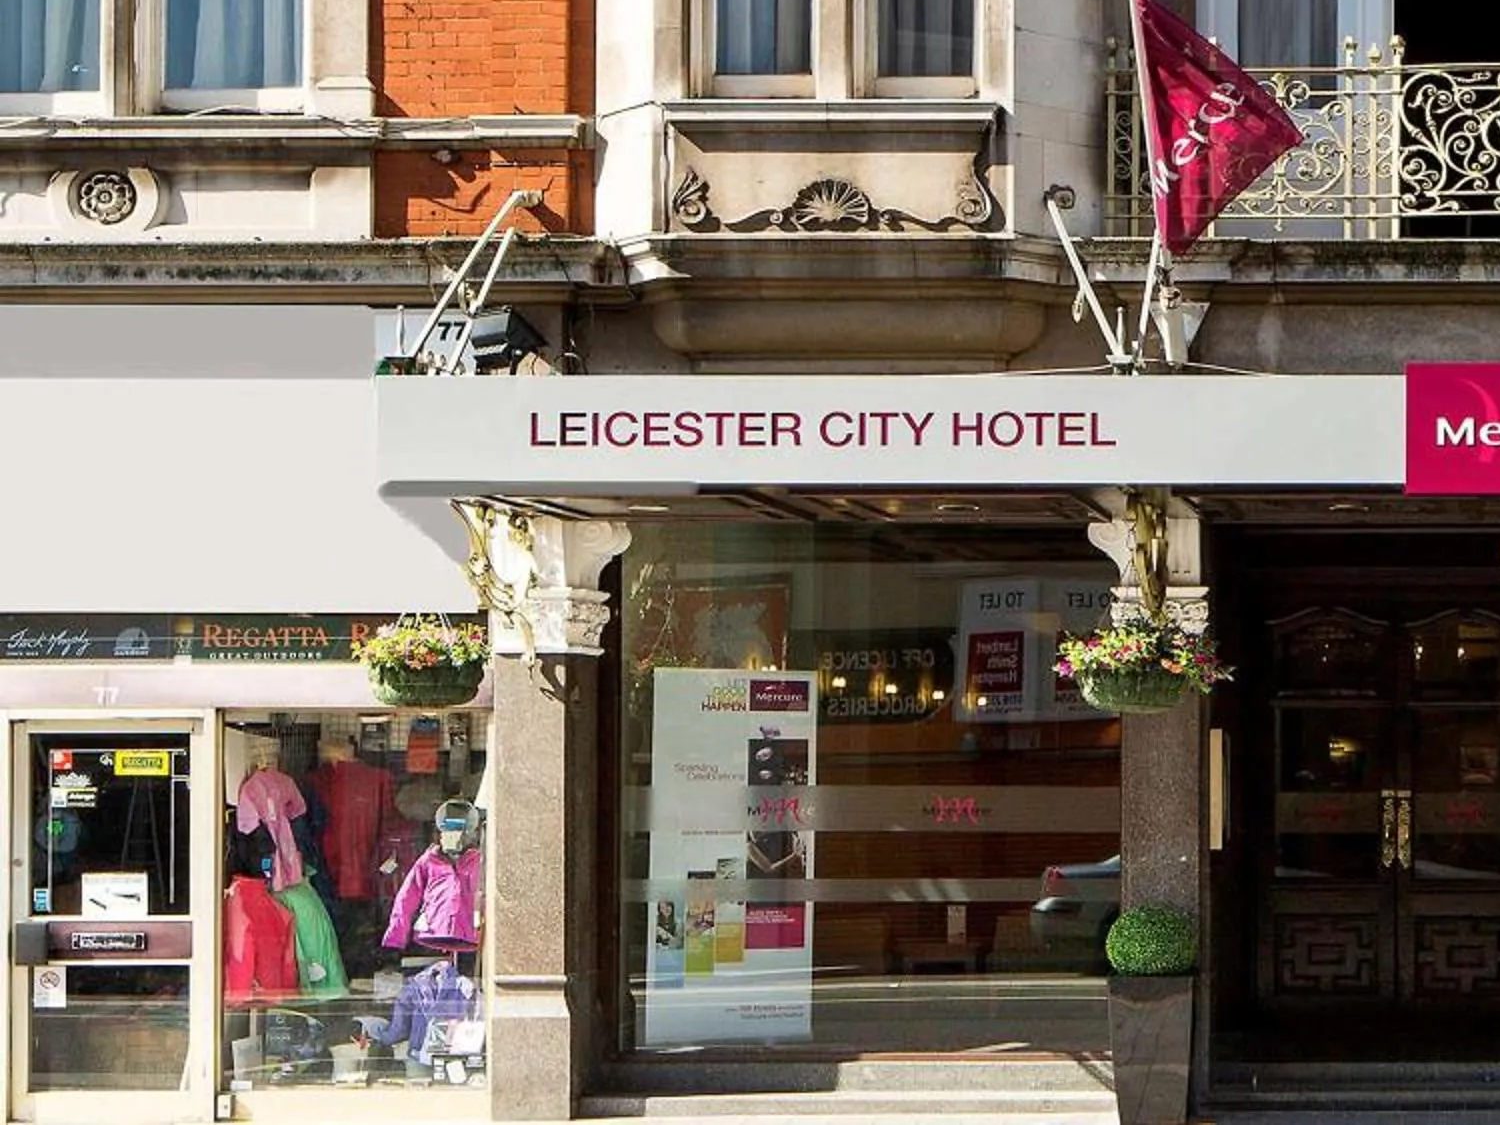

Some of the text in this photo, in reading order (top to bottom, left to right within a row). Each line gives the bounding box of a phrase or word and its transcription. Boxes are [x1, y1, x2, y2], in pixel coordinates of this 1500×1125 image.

[437, 322, 467, 341] 77
[529, 410, 1117, 447] LEICESTER CITY HOTEL
[209, 651, 249, 660] GREAT
[93, 687, 119, 704] 77
